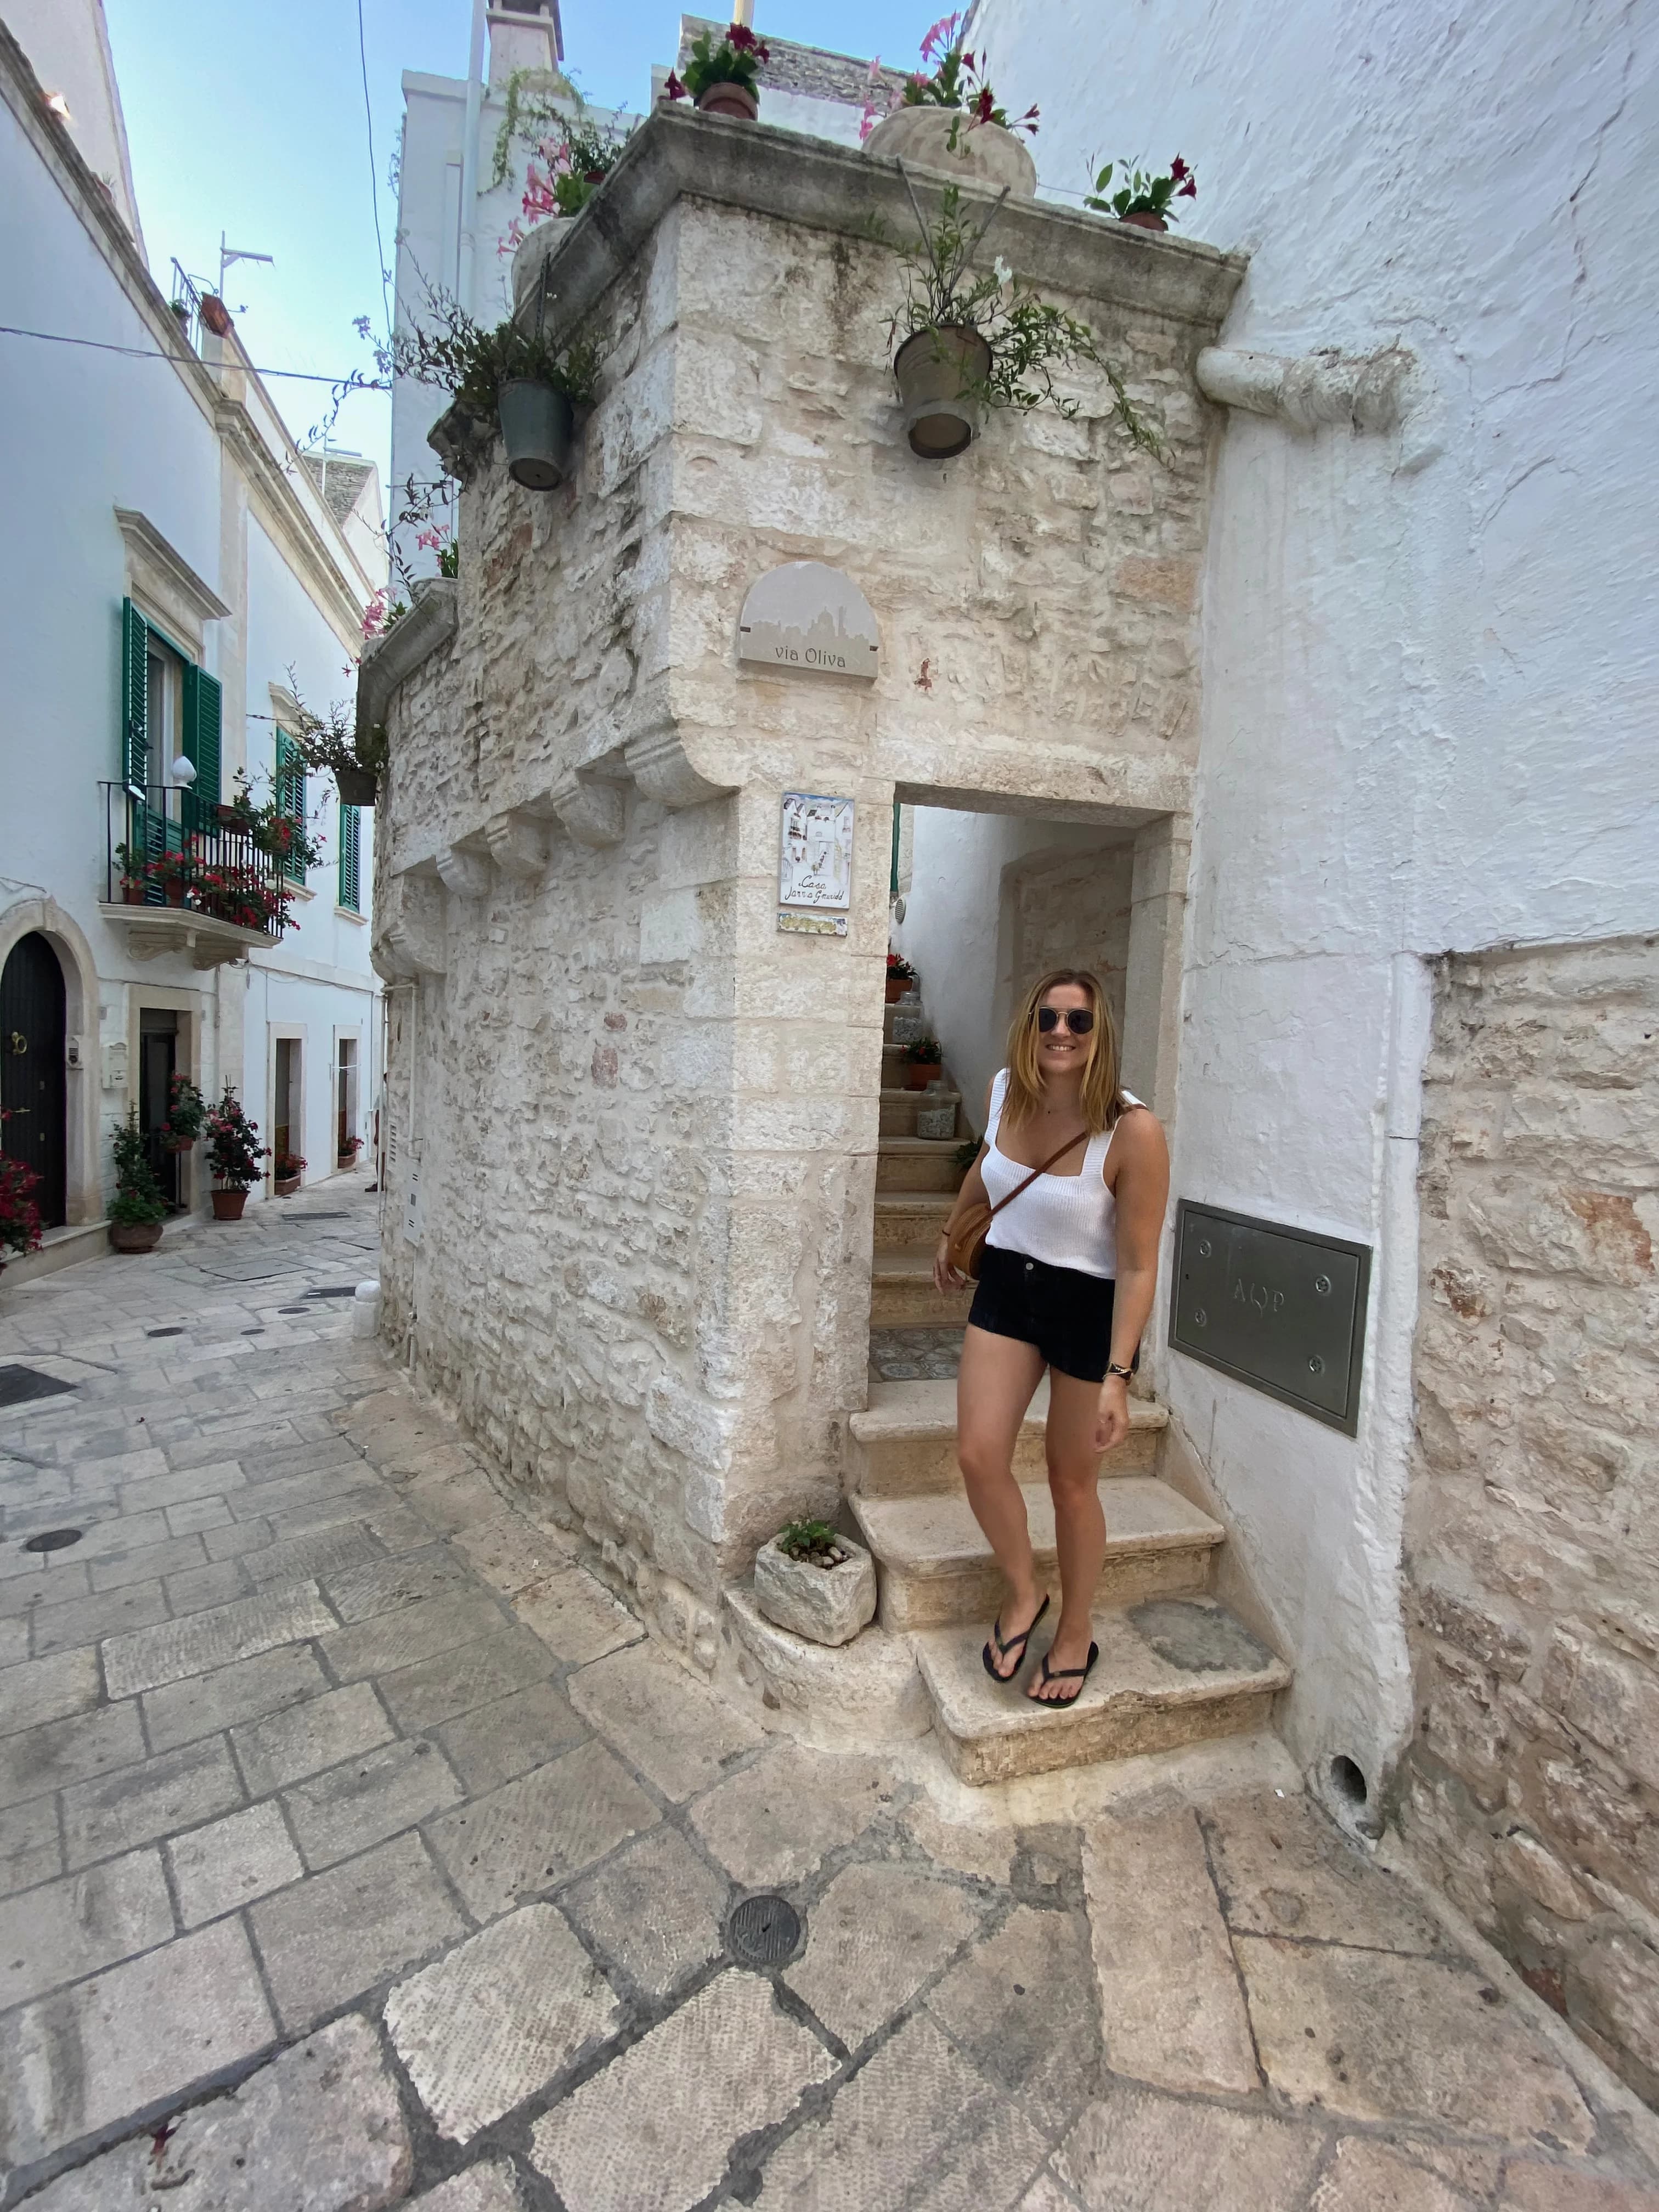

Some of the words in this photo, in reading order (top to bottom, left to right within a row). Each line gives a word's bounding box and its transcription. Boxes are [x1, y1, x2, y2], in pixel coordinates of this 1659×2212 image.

[775, 645, 798, 661] via
[805, 648, 845, 667] Oliva
[798, 875, 827, 889] Casa
[1234, 1278, 1284, 1316] AQP
